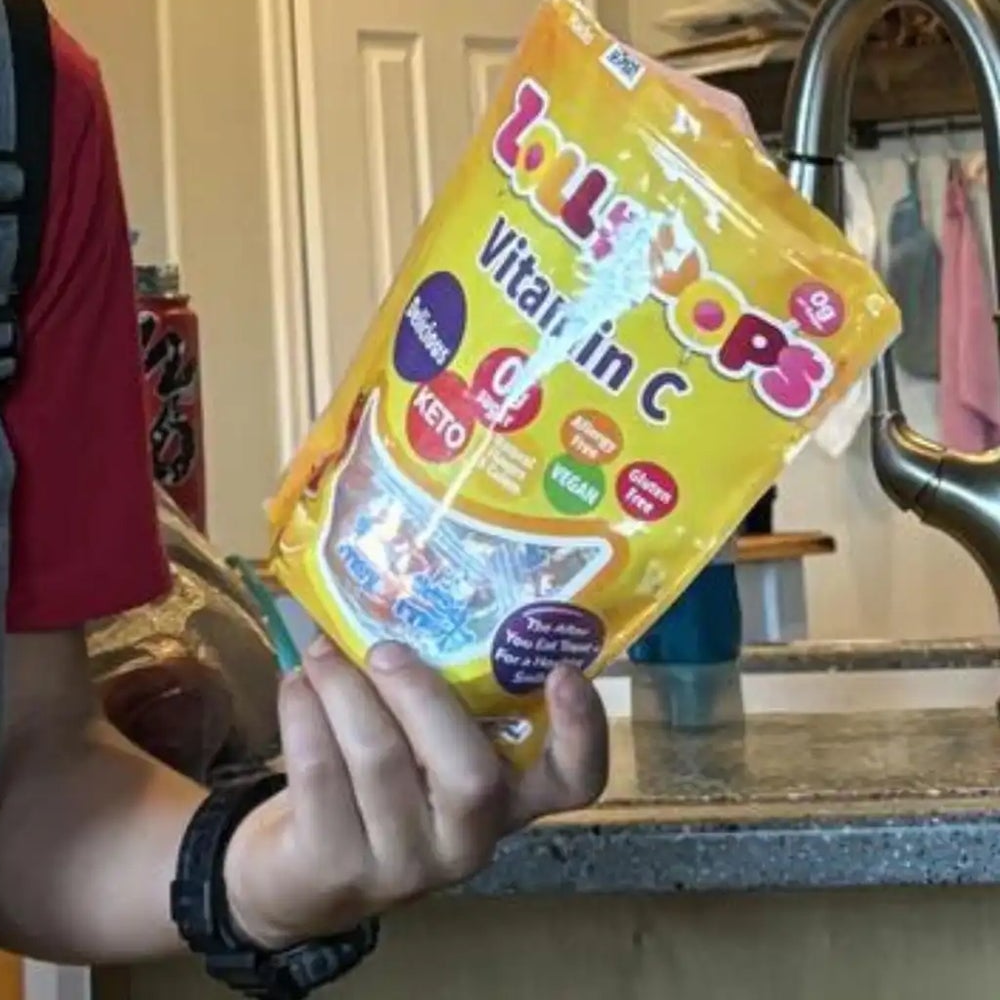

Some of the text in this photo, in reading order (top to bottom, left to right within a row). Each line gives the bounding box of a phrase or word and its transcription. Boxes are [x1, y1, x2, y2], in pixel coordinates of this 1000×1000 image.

[413, 384, 466, 449] KETO
[640, 371, 688, 422] C
[551, 461, 600, 507] VEGAN
[625, 487, 654, 514] Free
